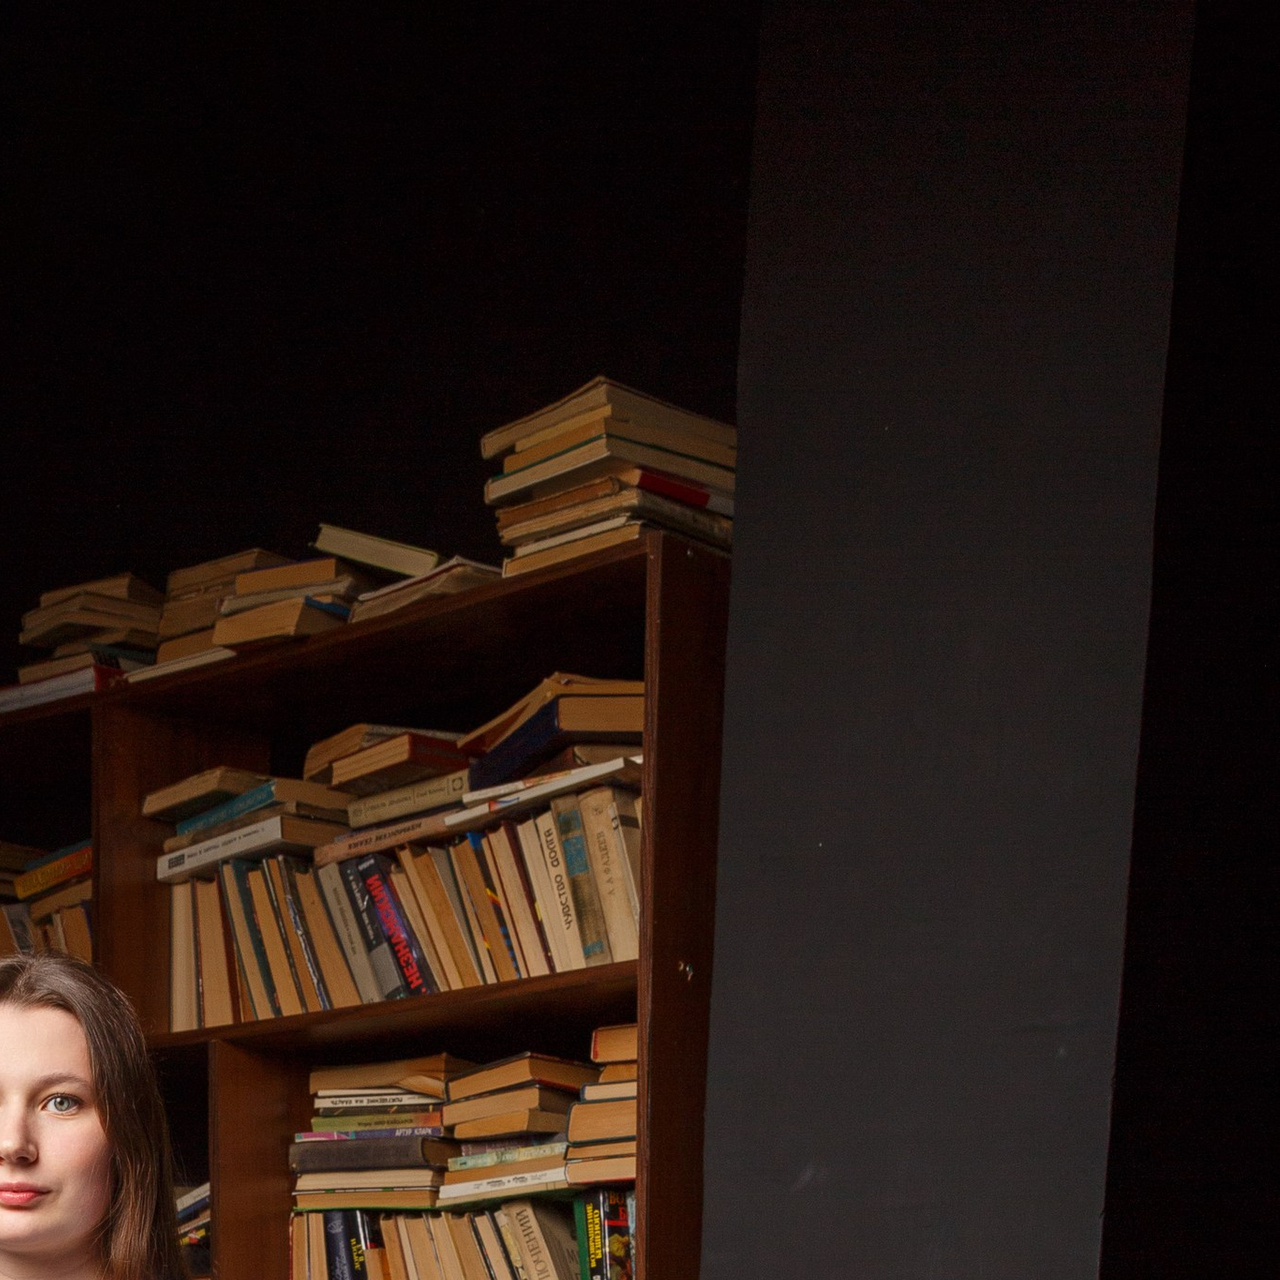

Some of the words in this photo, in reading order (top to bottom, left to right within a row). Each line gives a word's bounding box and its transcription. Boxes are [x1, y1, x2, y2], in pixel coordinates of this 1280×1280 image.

[544, 828, 560, 868] ДОЛГА
[554, 874, 571, 930] ЧУВСТВО
[365, 873, 423, 989] НЕЗНАНСКИЙ
